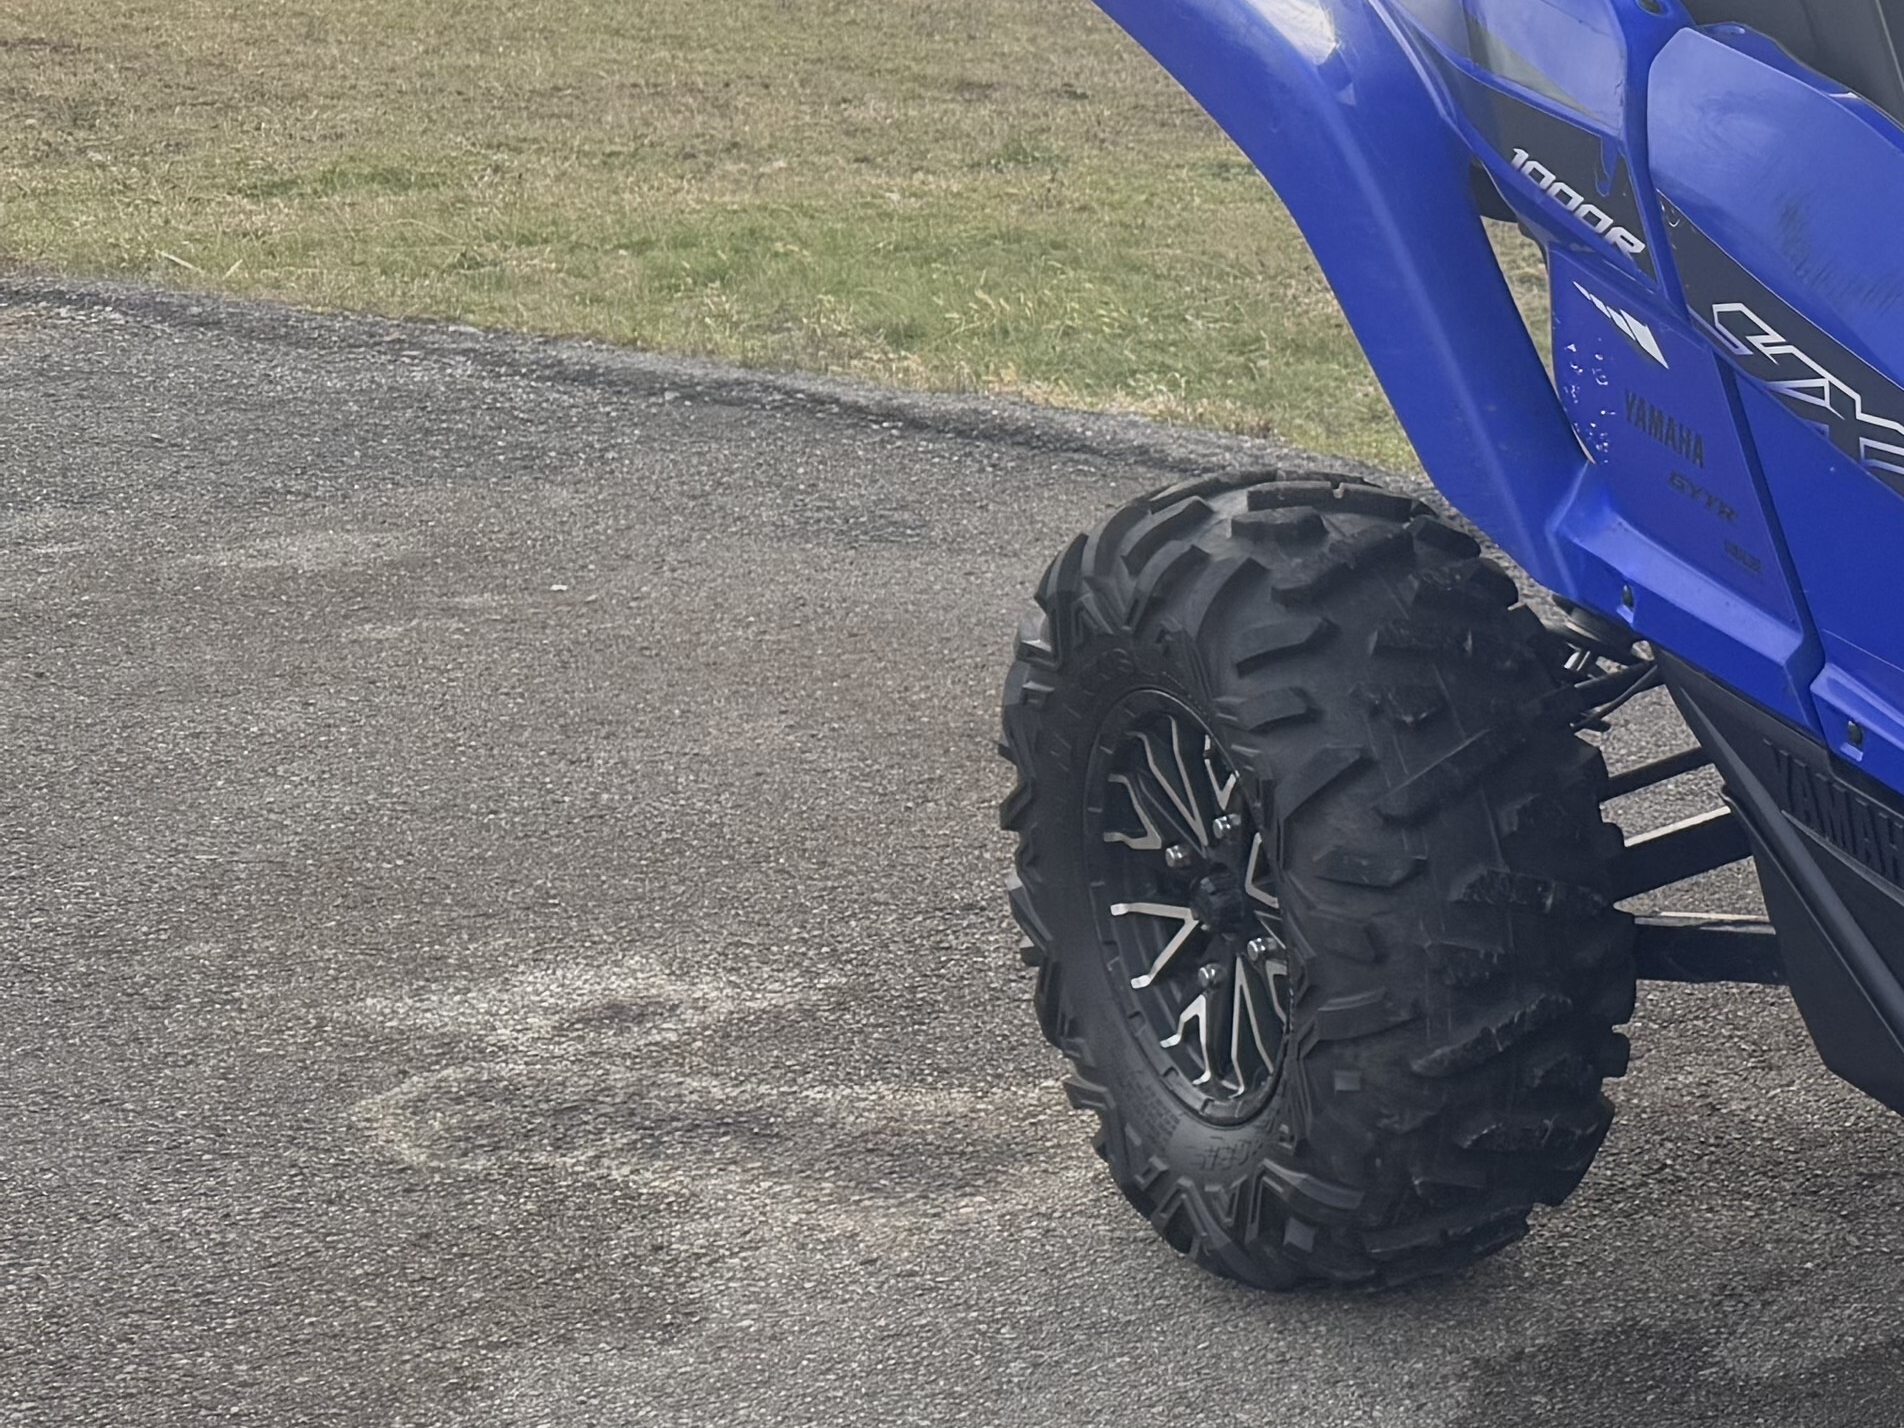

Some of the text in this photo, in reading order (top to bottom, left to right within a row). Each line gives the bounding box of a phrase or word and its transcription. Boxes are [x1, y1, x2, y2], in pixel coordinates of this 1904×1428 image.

[1511, 148, 1646, 261] 1000R
[1625, 388, 1705, 468] YAMAHA
[1669, 470, 1739, 523] GYTR
